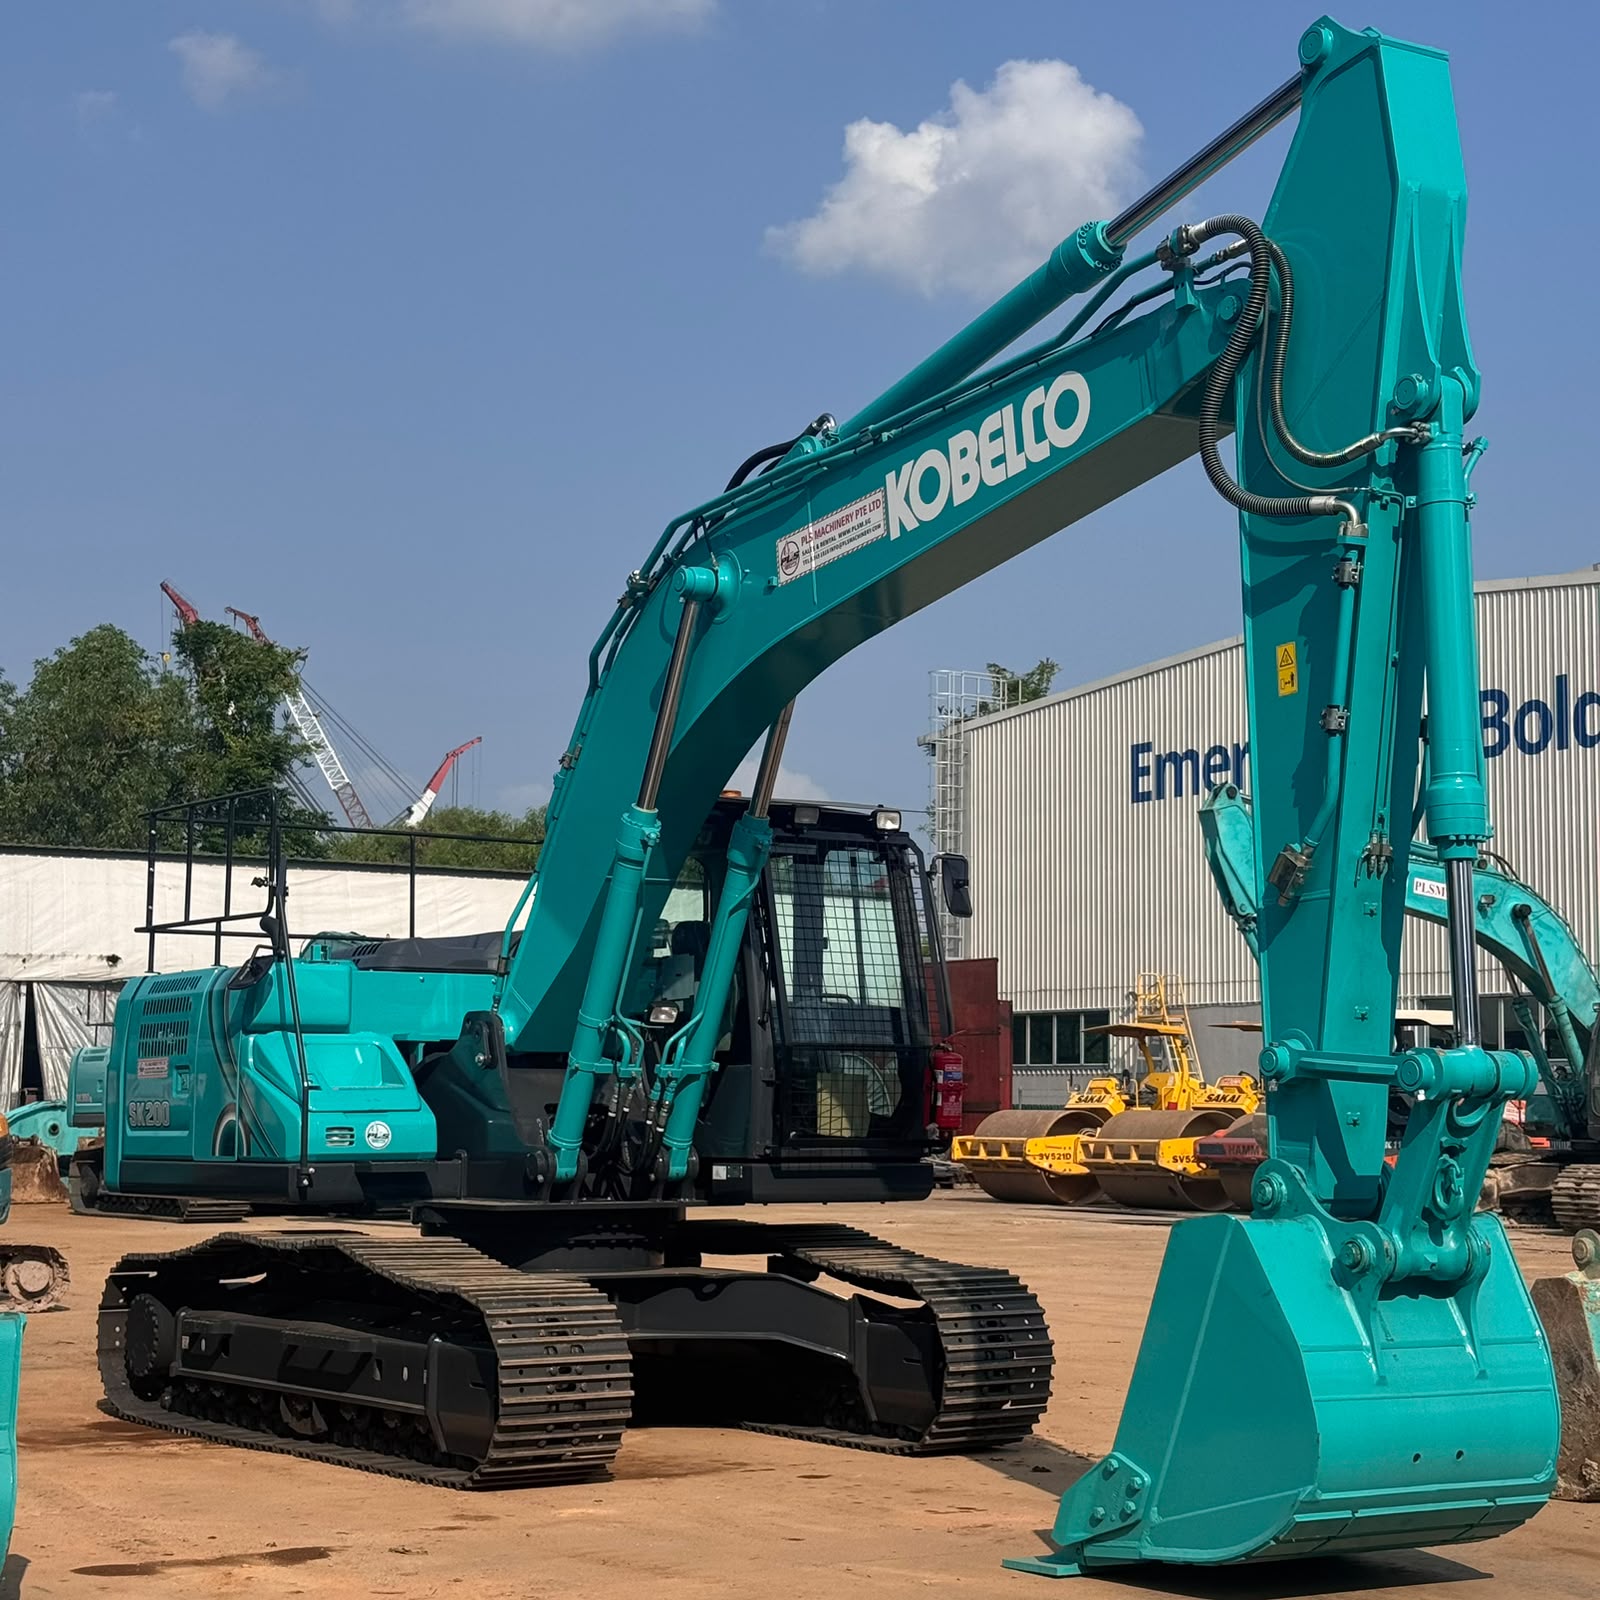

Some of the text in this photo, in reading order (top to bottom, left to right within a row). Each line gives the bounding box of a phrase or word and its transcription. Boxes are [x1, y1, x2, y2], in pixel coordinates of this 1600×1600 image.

[885, 370, 1091, 541] KOBELCO
[800, 498, 882, 546] PLS MACHINERY PTE LTD
[780, 550, 800, 566] PLS
[1415, 880, 1446, 897] PLSM
[1075, 1093, 1107, 1104] SAKAI
[1204, 1093, 1242, 1104] SAKAI
[128, 1100, 170, 1127] SK200
[367, 1132, 389, 1140] PLS
[1038, 1152, 1072, 1161] SV521D
